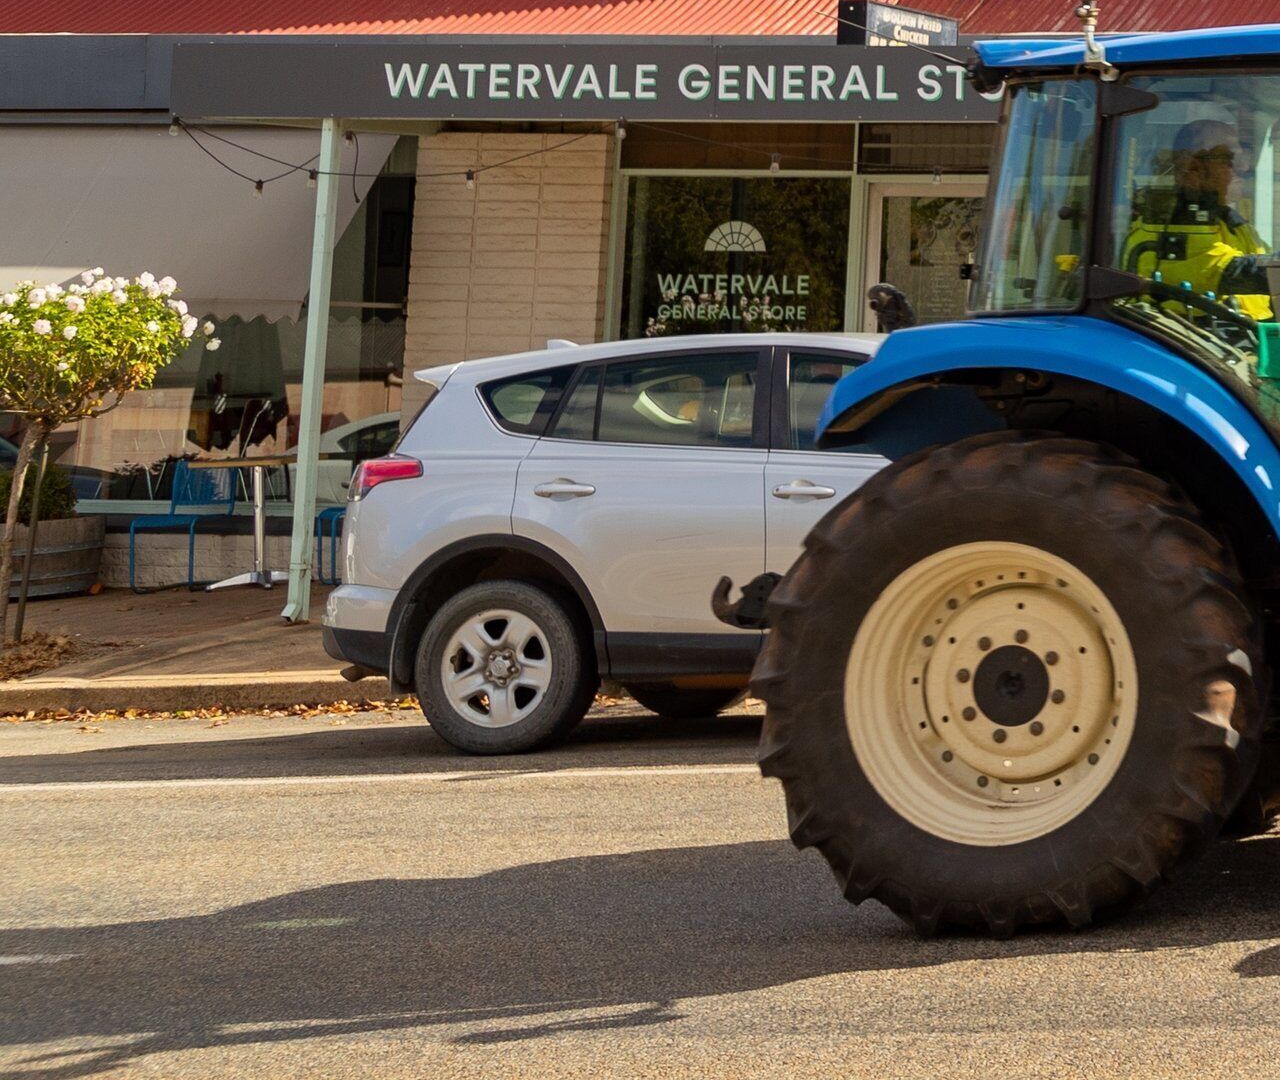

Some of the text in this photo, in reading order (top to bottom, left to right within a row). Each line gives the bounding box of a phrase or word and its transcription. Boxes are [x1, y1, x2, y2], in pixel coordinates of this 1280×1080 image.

[918, 15, 943, 33] FRIED
[893, 25, 930, 46] CHICKEN
[384, 63, 659, 100] WATERVALE
[678, 64, 899, 101] GENERAL
[657, 273, 810, 296] WATERVALE
[657, 304, 807, 321] GENERAL STORE
